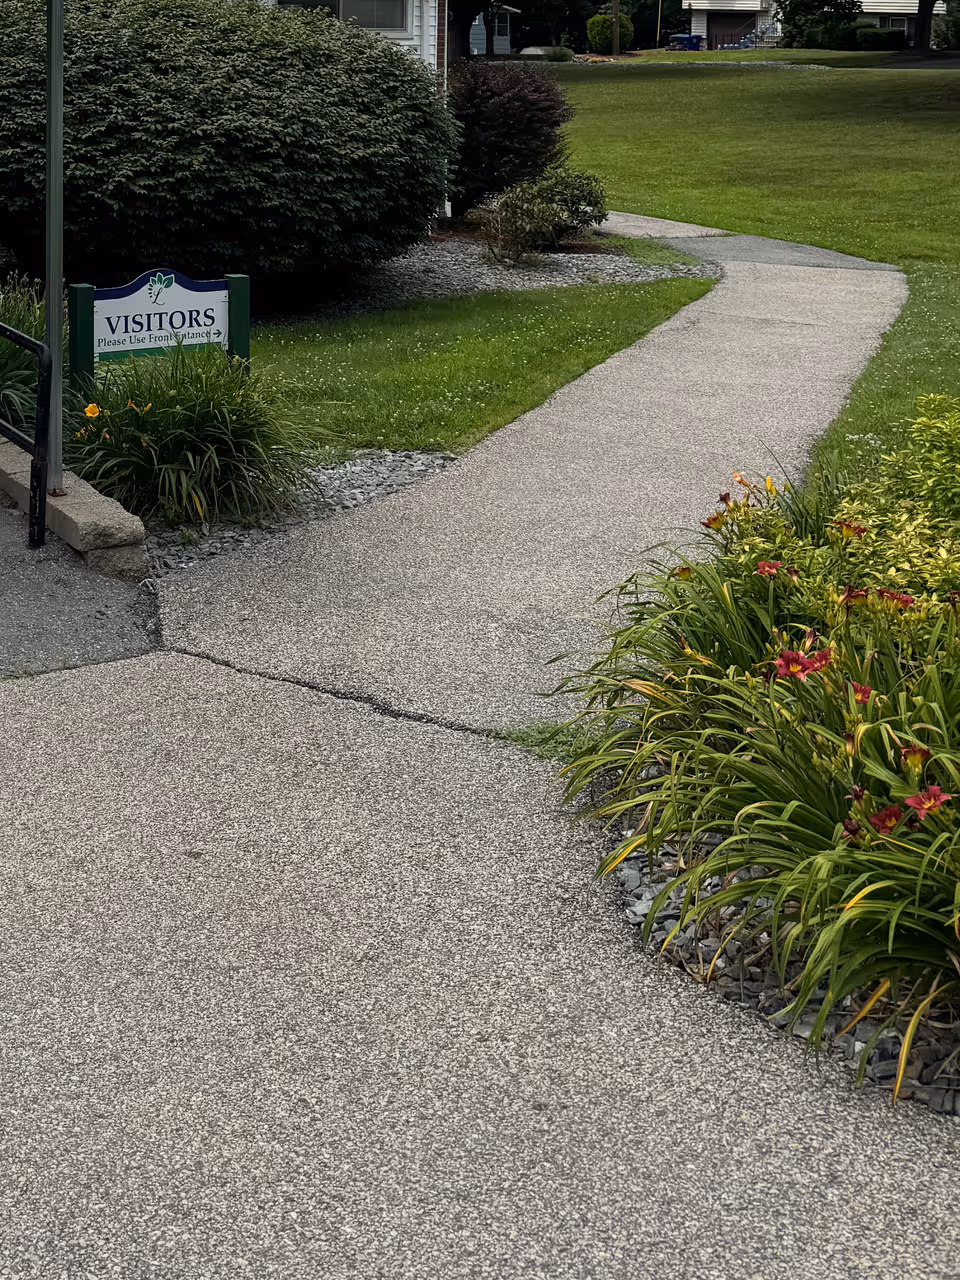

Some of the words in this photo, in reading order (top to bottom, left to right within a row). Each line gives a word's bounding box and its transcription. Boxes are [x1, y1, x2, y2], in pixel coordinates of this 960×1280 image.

[105, 308, 216, 335] VISITORS
[97, 337, 127, 347] Please
[129, 334, 146, 344] Use
[148, 332, 173, 342] Front
